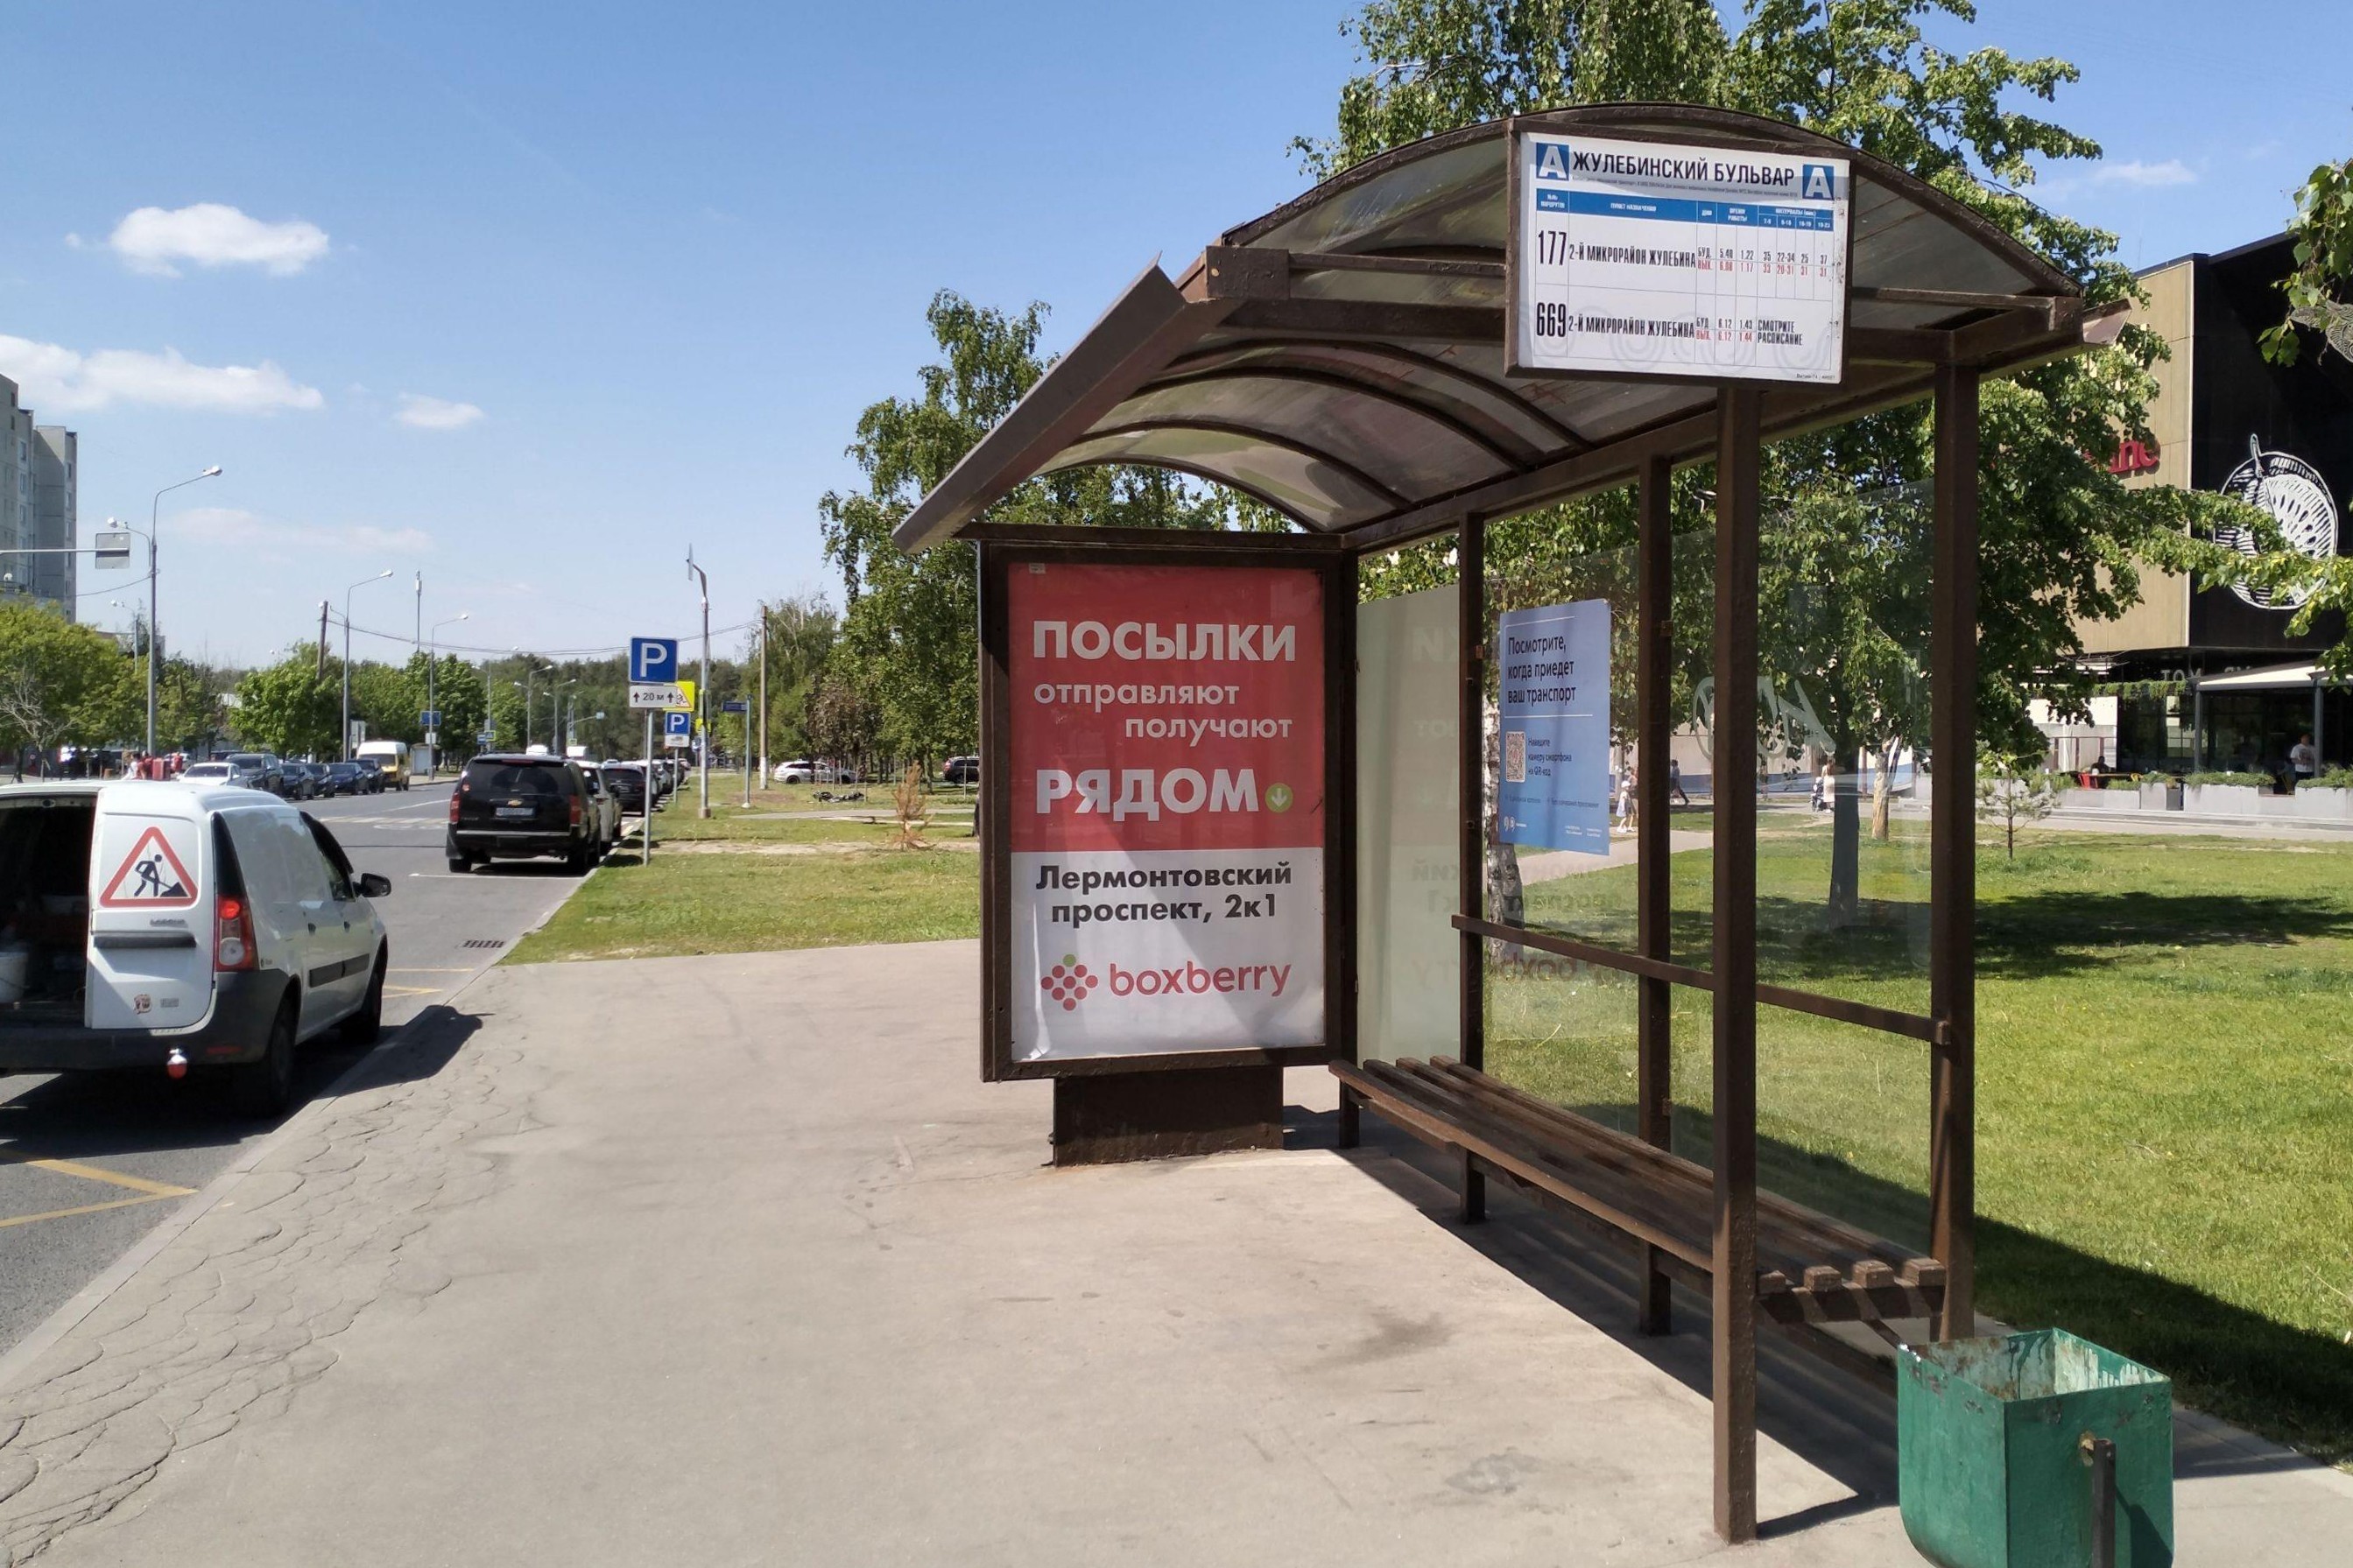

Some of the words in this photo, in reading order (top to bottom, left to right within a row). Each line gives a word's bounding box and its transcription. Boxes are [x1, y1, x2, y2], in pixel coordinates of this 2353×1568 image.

[1573, 151, 1708, 182] ЖУЛЕБИНСКИЙ
[1714, 162, 1795, 186] БУЛЬВАР
[1538, 229, 1567, 267] 177
[1569, 242, 1584, 261] 2-Й
[1587, 243, 1646, 266] МИКРОРАЙОН
[1648, 249, 1696, 269] ЖУЛЕБИНА
[1536, 302, 1567, 337] 669
[1568, 313, 1583, 332] 2-Й
[1586, 316, 1645, 335] МИКРОРАЙОН
[1647, 320, 1695, 339] ЖУЛЕБИНА
[1758, 320, 1796, 334] СМОТРИТЕ
[1033, 620, 1296, 662] ПОСЫЛКИ
[1508, 635, 1567, 655] Посмотрите,
[640, 642, 667, 678] P
[1507, 664, 1532, 681] когда
[1534, 659, 1575, 682] приедет
[643, 692, 655, 701] 20
[1033, 683, 1240, 714] отправляют
[1507, 690, 1525, 704] ваш
[1526, 685, 1576, 707] транспорт
[1125, 718, 1293, 747] получают
[1036, 768, 1259, 822] РЯДОМ
[1035, 861, 1292, 895] Лермонтовский
[1052, 898, 1213, 929] проспект,
[1224, 893, 1276, 919] 2к1
[1109, 960, 1292, 998] boxberry
